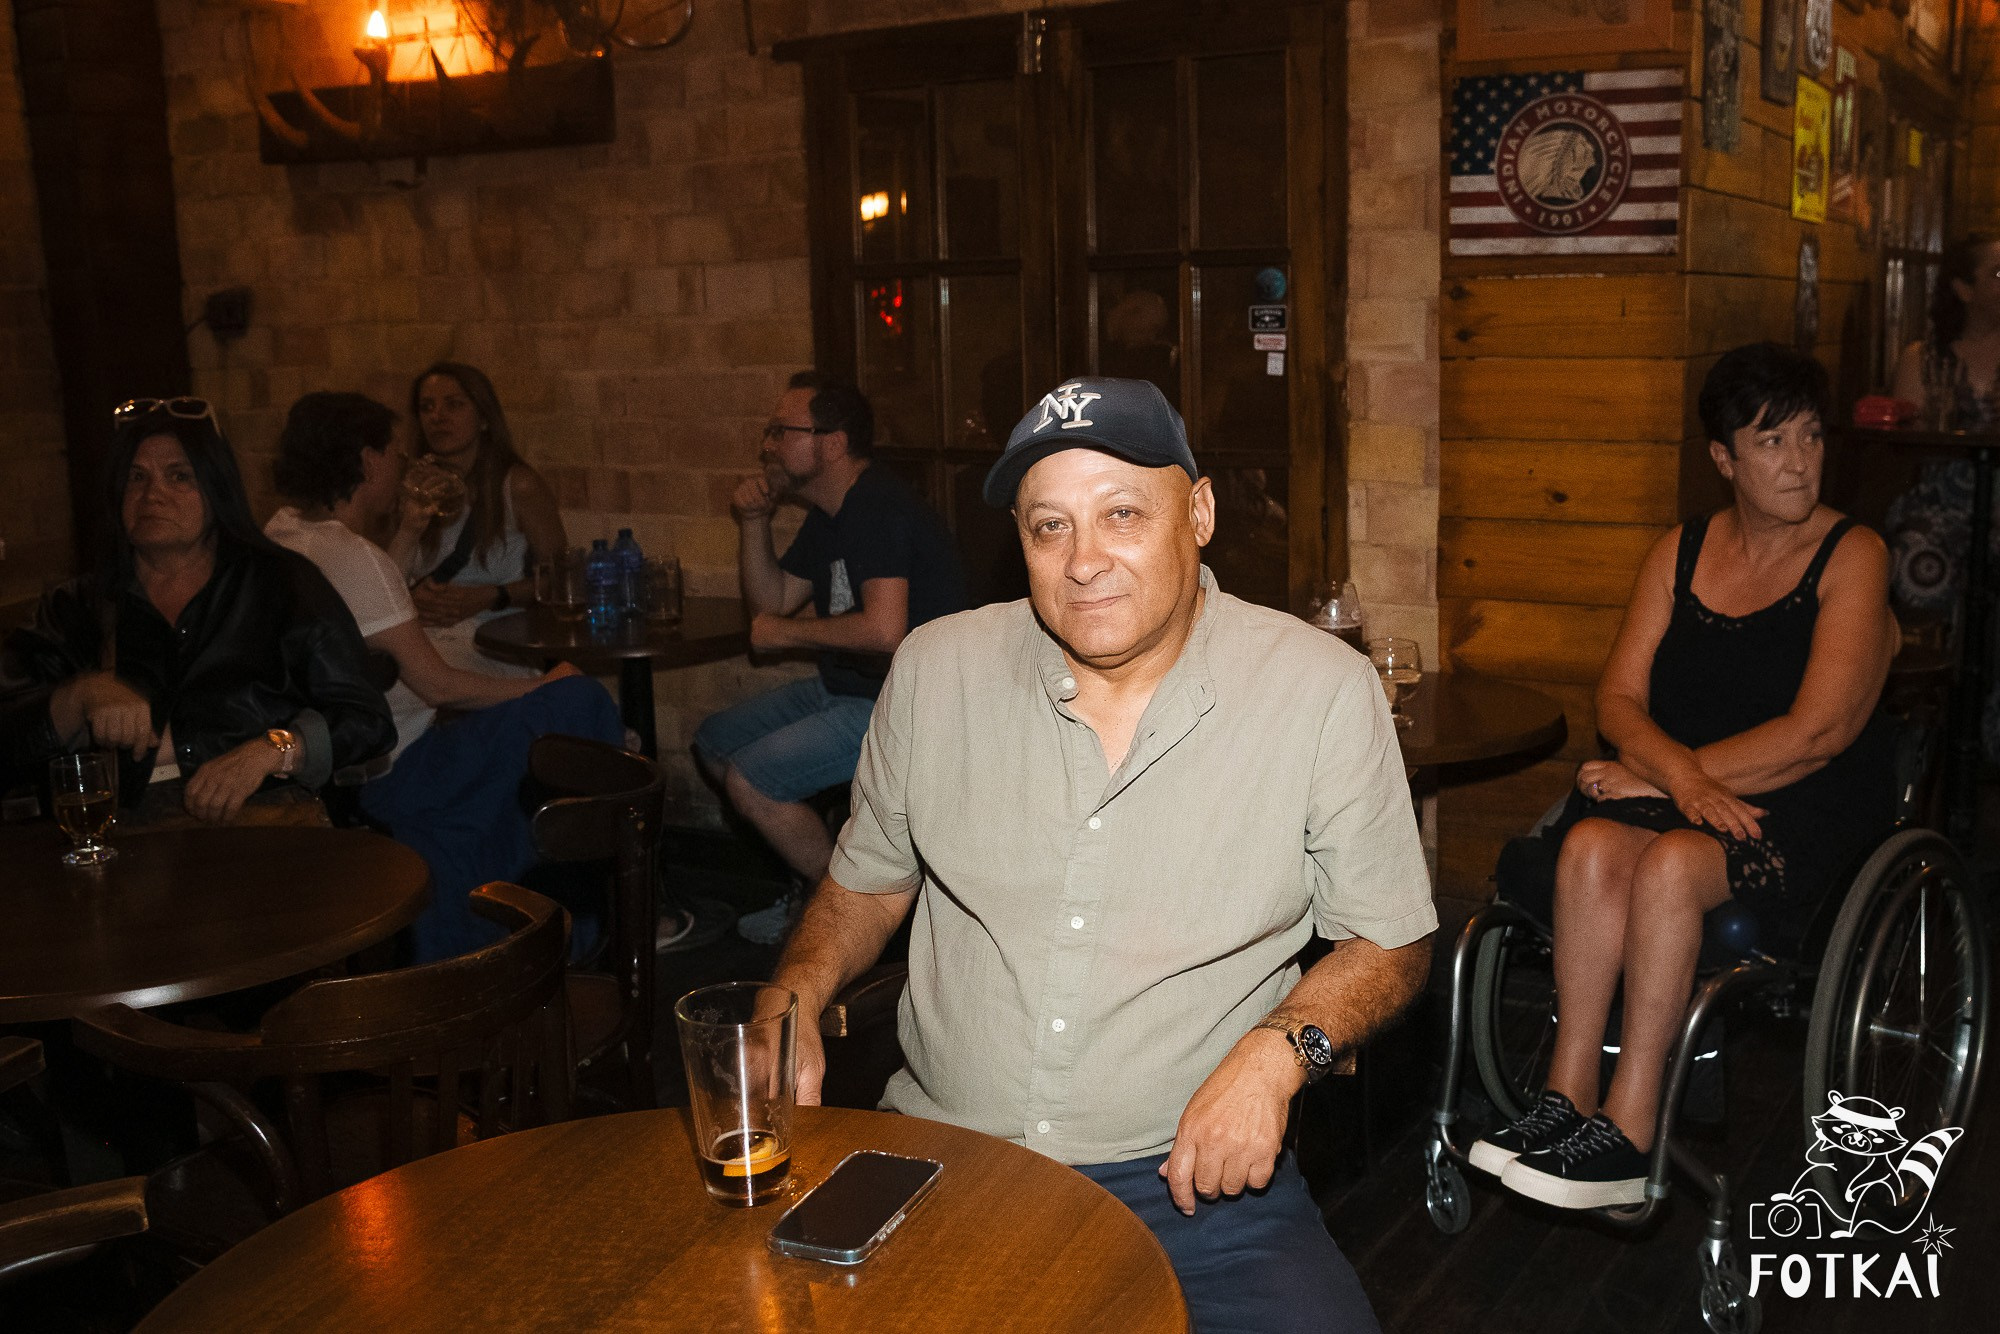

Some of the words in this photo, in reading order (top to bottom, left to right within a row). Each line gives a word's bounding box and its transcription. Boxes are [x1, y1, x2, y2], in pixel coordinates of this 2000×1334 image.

[1502, 119, 1530, 204] INDIAN
[1535, 101, 1623, 202] MOTORCYCLE
[1538, 212, 1583, 226] 1901
